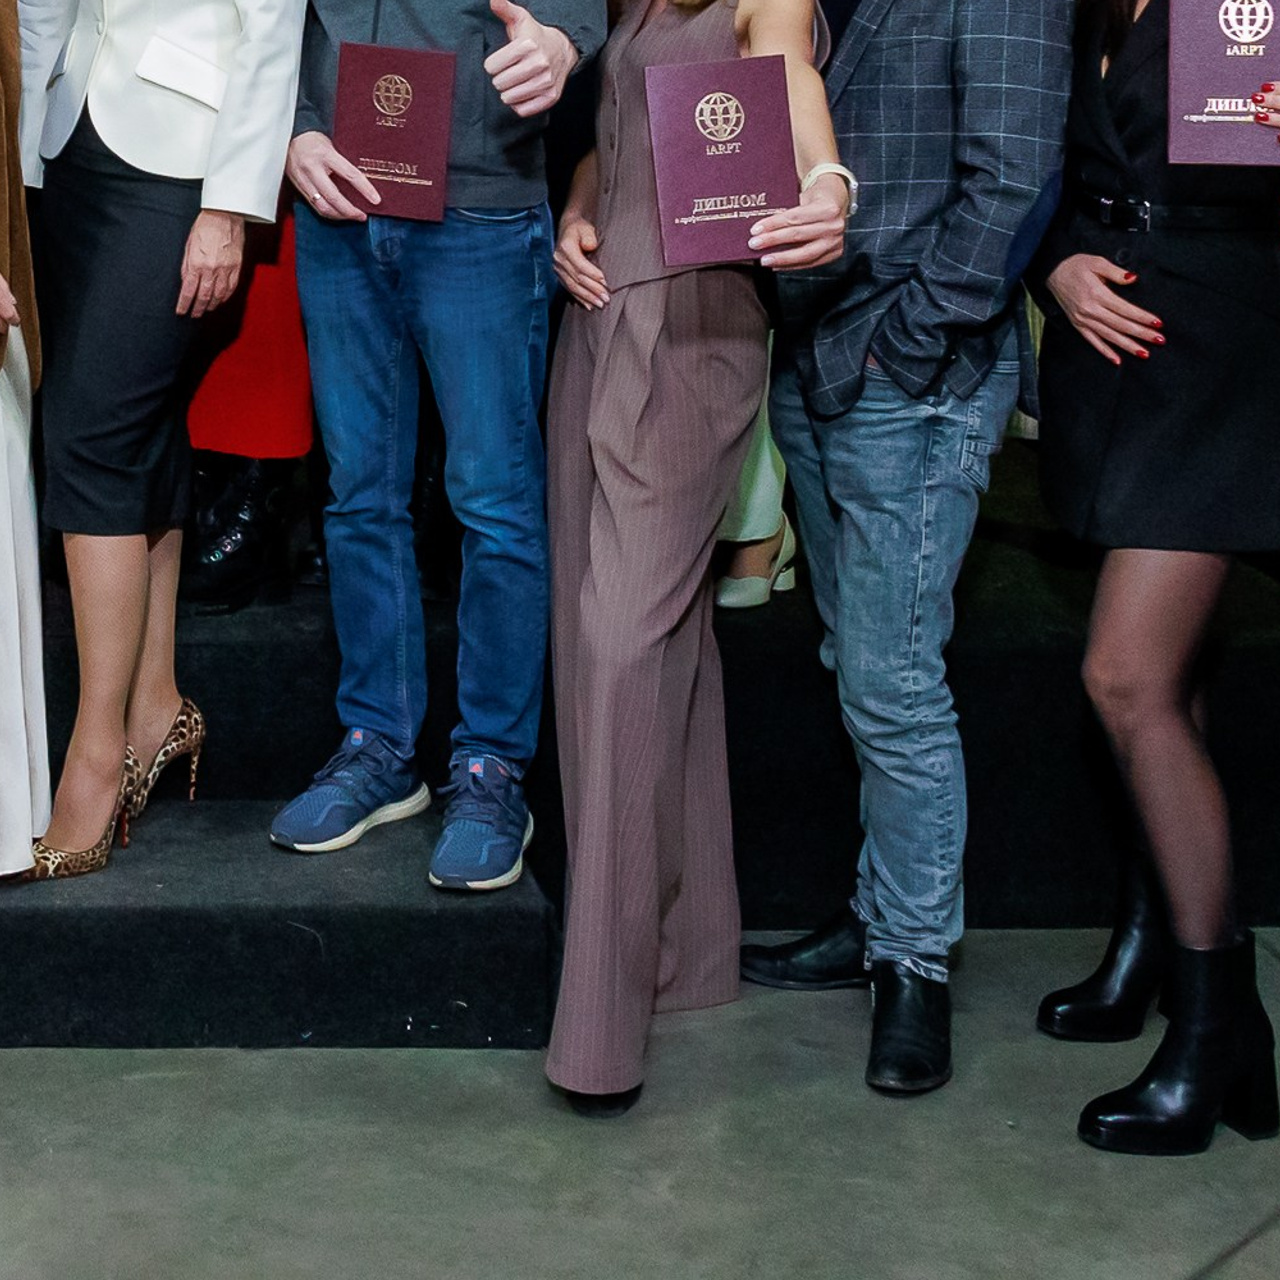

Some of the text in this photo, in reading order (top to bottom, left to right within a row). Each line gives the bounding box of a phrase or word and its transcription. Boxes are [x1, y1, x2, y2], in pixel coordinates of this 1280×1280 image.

[1226, 44, 1265, 56] iARPT
[1204, 98, 1275, 114] ДИПЛ
[706, 142, 742, 155] iARPT
[359, 157, 418, 176] ДИПЛОМ
[692, 193, 766, 214] ДИПЛОМ
